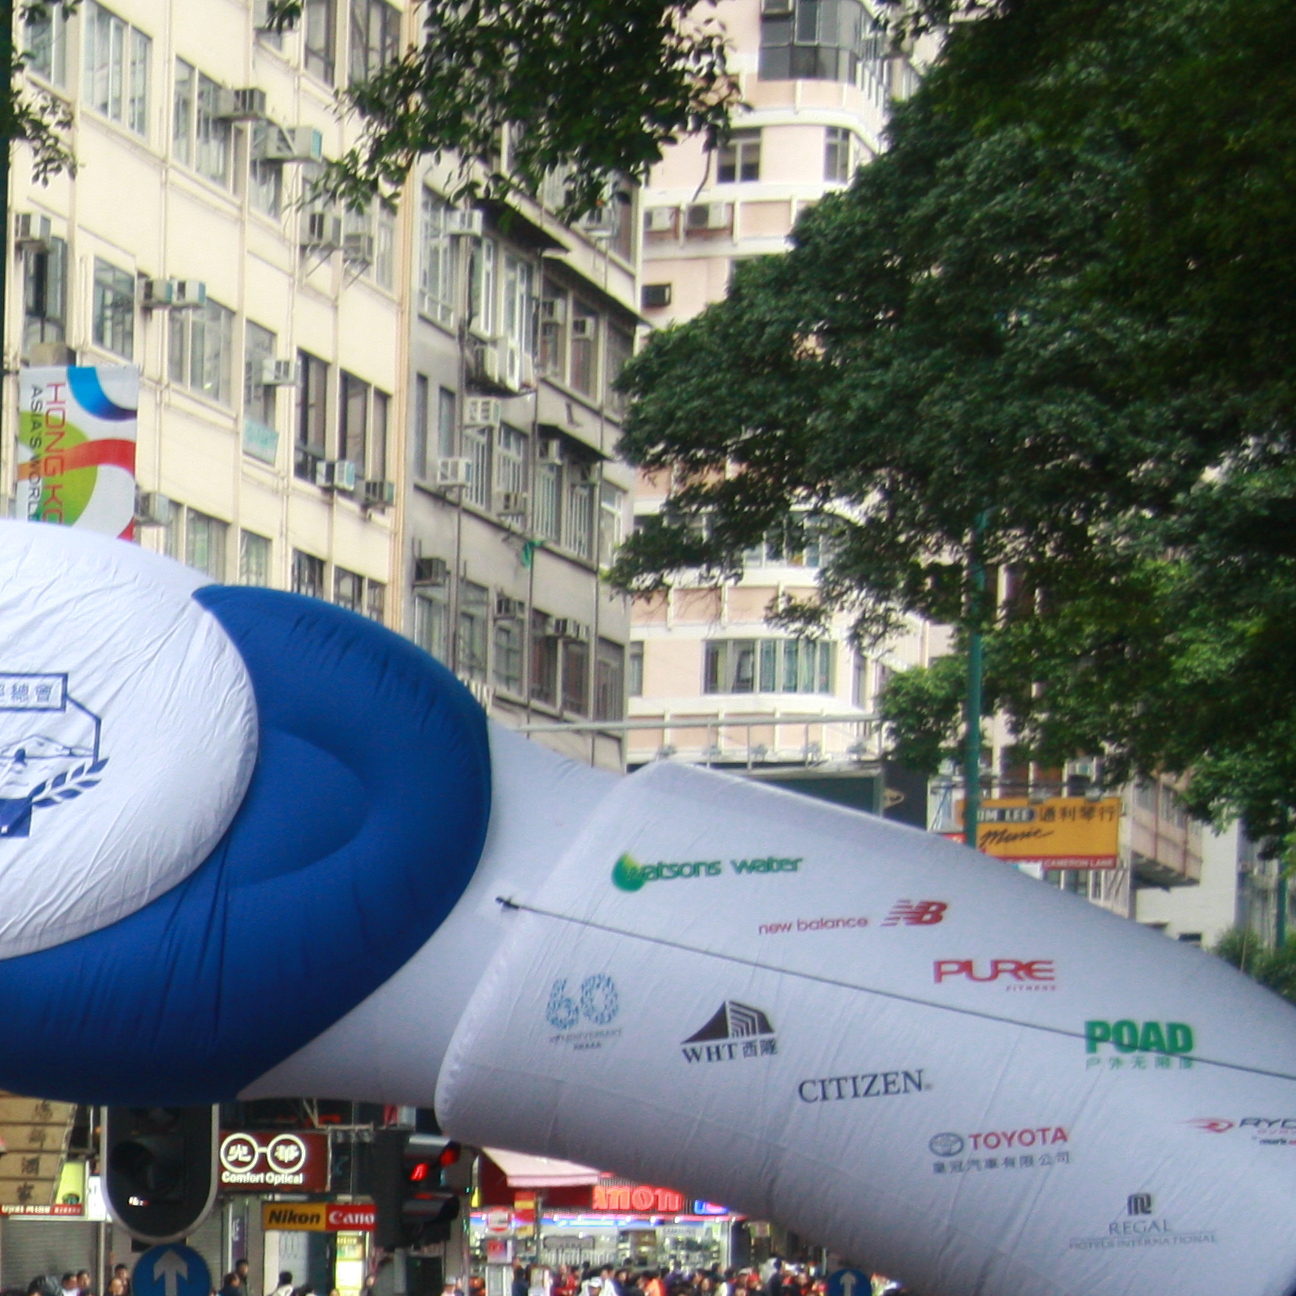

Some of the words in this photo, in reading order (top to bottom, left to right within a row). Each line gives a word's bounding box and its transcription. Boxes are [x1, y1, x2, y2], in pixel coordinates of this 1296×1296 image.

[43, 382, 66, 477] HONG
[41, 484, 64, 524] KO
[730, 856, 803, 876] water
[758, 921, 792, 936] new
[796, 916, 869, 932] balance
[933, 959, 1056, 985] PURE
[1084, 1019, 1194, 1055] POAD
[681, 1044, 739, 1065] WHT
[797, 1068, 925, 1104] CITIZEN
[968, 1126, 1069, 1151] TOYOTA
[221, 1170, 265, 1184] Comfort
[265, 1172, 304, 1186] Optical
[267, 1208, 321, 1225] Nikon
[327, 1209, 376, 1225] Cano
[1108, 1218, 1175, 1236] REGAL
